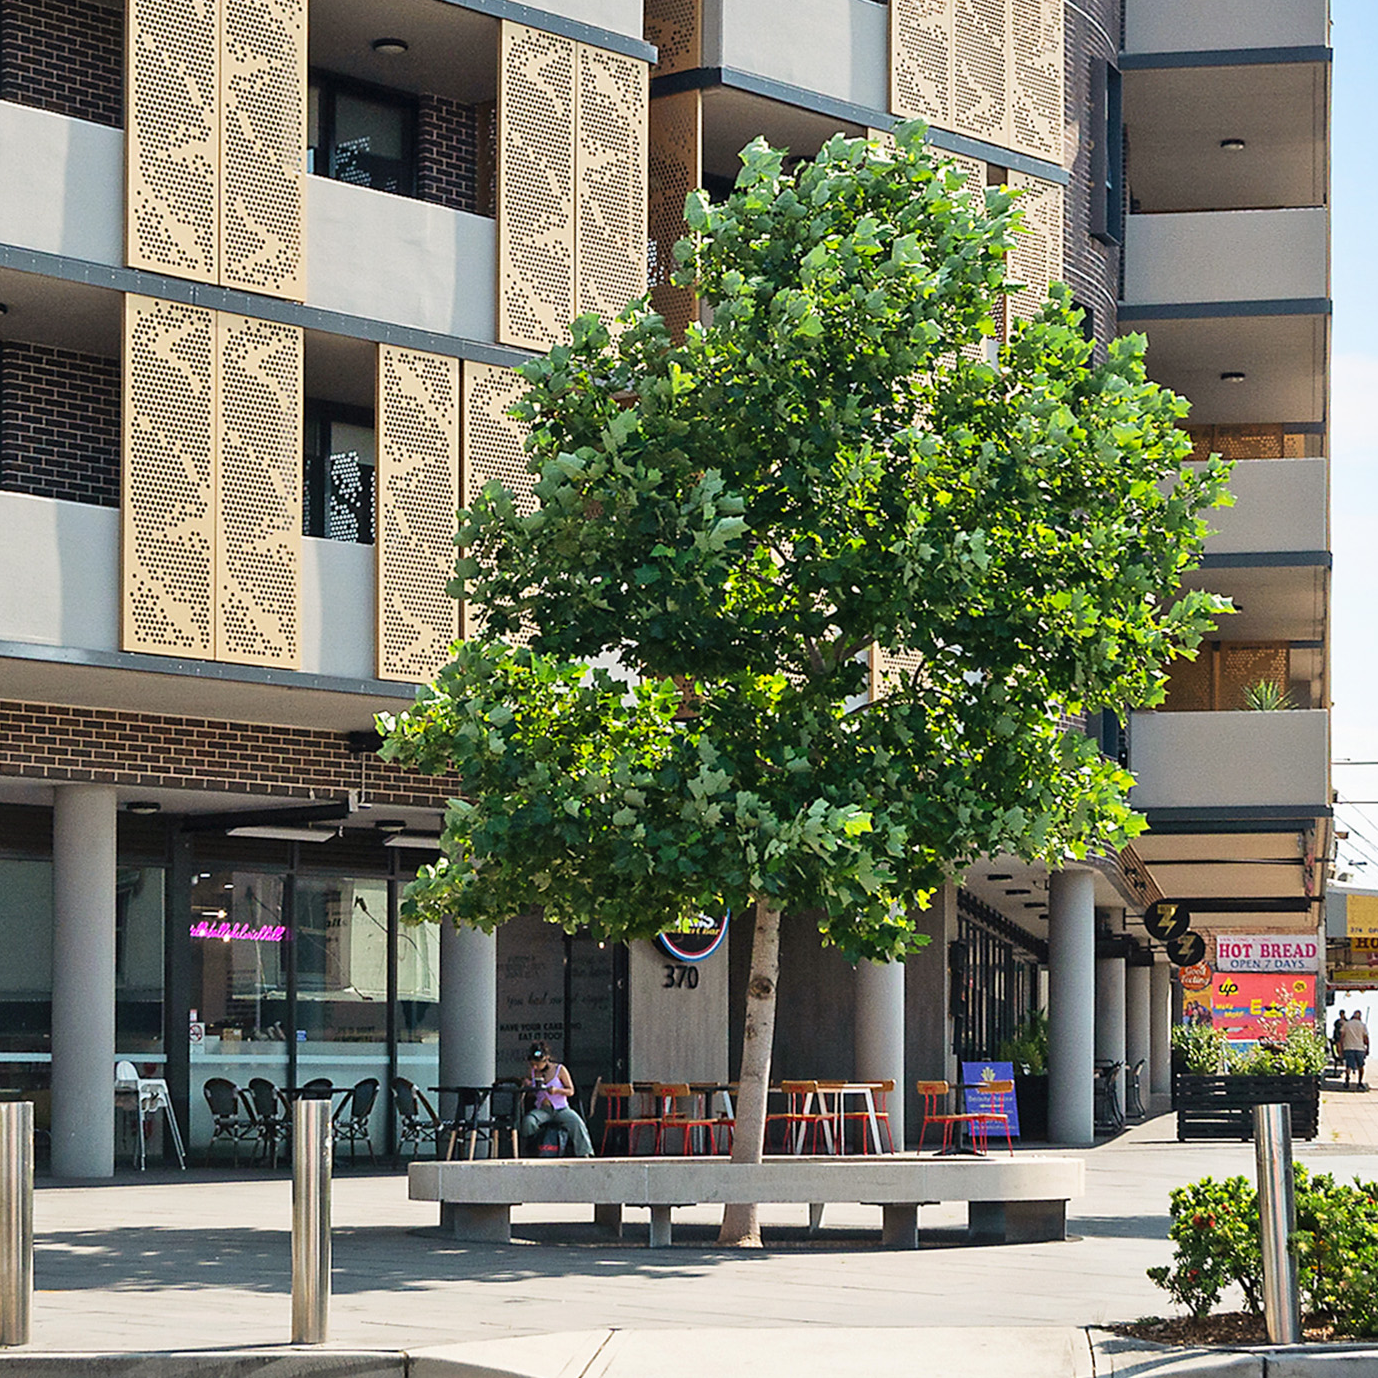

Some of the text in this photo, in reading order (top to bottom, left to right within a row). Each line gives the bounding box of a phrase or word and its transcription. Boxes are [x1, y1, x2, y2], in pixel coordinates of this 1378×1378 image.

[1219, 943, 1317, 958] HOT BREAD
[1230, 959, 1305, 969] OPEN 7 DAYS
[663, 965, 699, 989] 370
